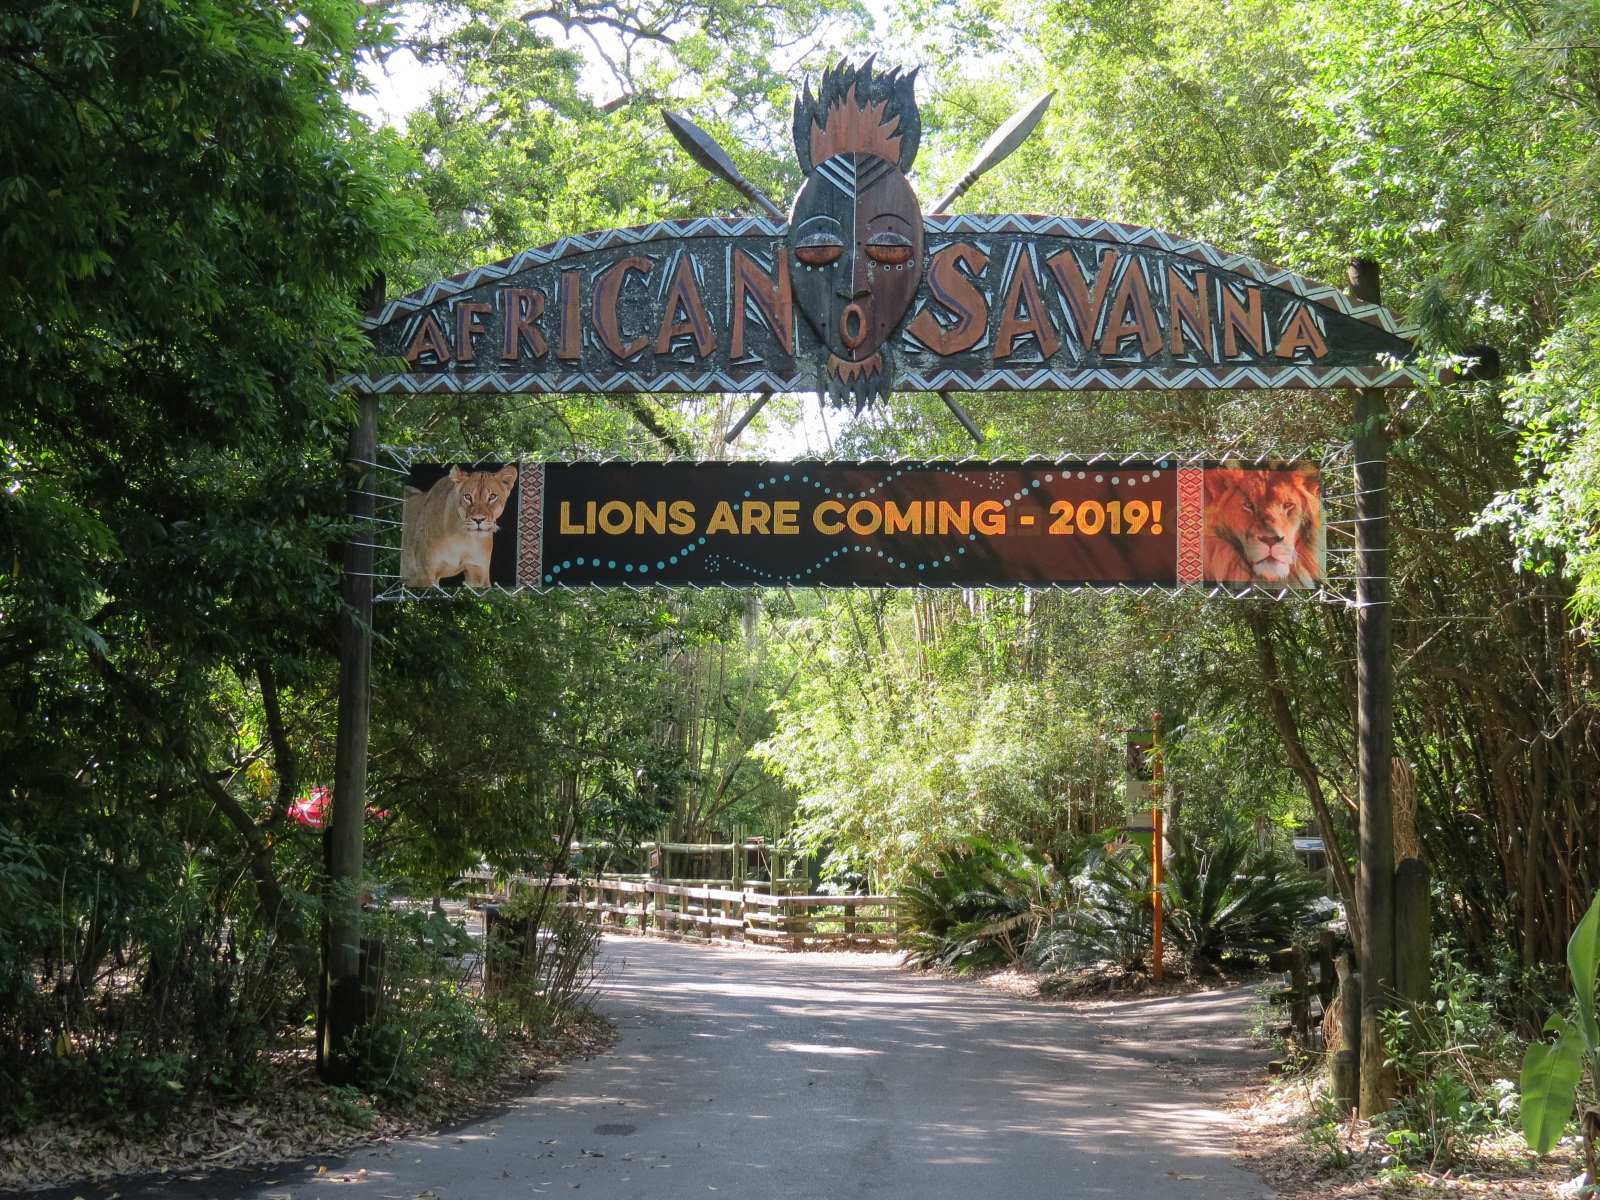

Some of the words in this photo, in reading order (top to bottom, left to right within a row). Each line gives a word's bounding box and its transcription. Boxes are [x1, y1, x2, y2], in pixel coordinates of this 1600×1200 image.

[407, 248, 794, 362] AFRICAN
[907, 242, 1328, 359] SAVANNA
[560, 501, 696, 535] LIONS
[706, 501, 800, 535] ARE
[813, 500, 1006, 535] COMING
[1020, 515, 1035, 525] -
[1049, 500, 1163, 535] 2019!
